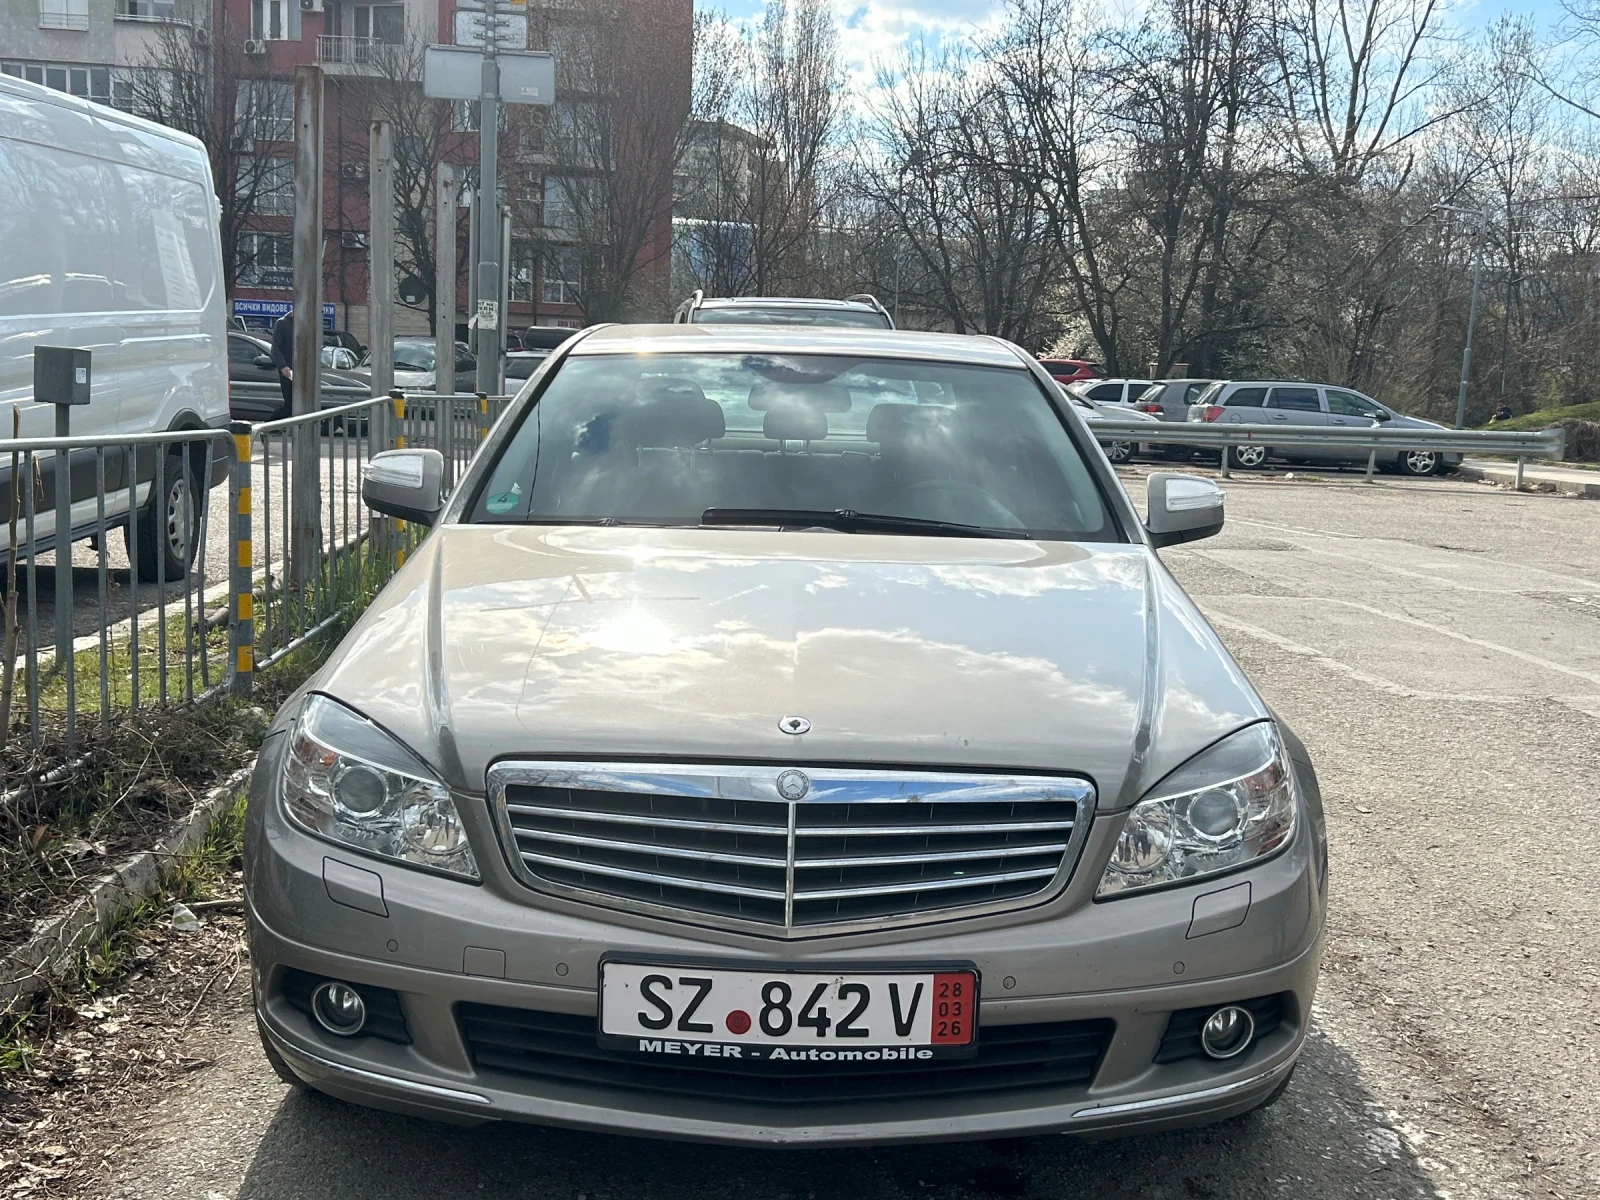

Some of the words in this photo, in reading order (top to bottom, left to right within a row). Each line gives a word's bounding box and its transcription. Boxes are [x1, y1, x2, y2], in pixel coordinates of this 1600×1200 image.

[234, 302, 260, 311] ВСИЧКИ
[262, 303, 288, 313] ВИДОВЕ
[497, 493, 508, 503] 4
[939, 982, 962, 997] 28
[638, 974, 713, 1033] SZ
[759, 981, 870, 1037] 842
[888, 983, 924, 1036] V
[939, 1002, 962, 1016] 03
[938, 1021, 961, 1036] 26
[640, 1040, 742, 1058] MEYER
[769, 1047, 933, 1060] Automobile
